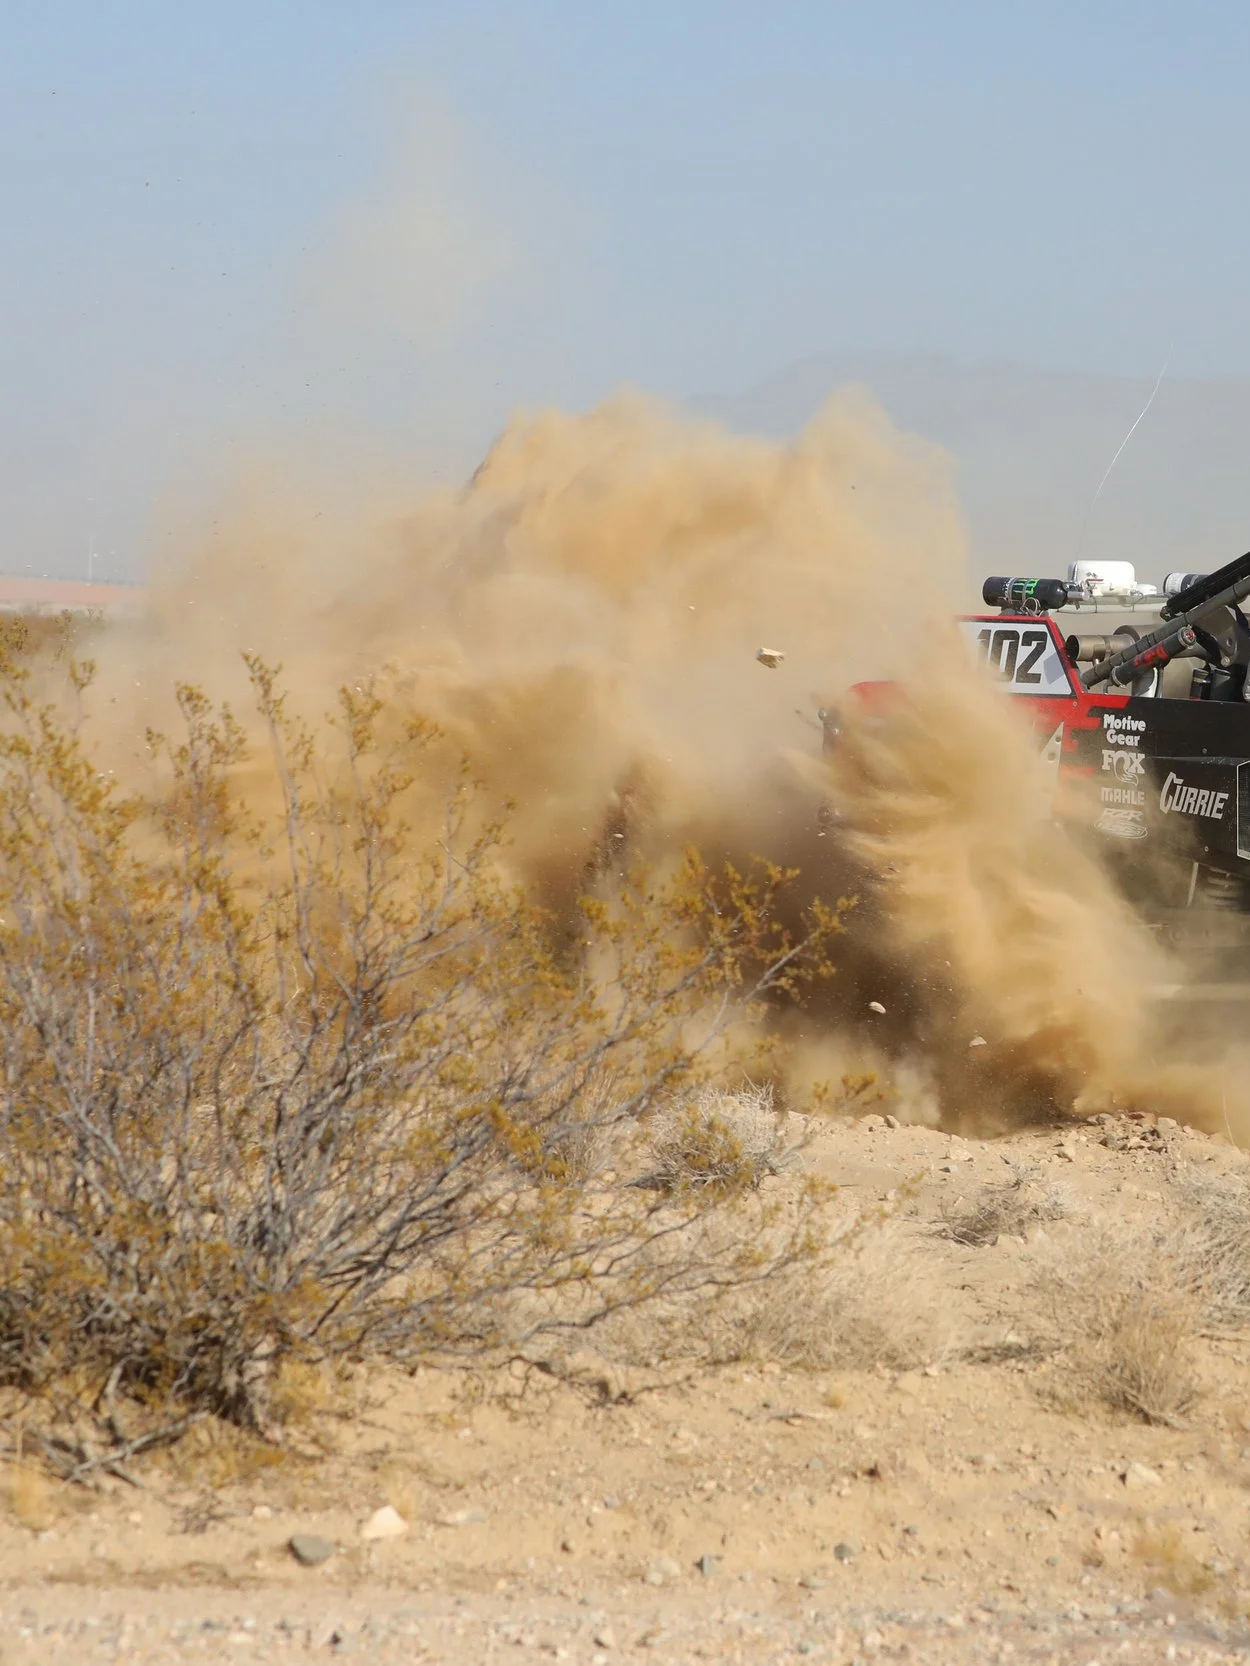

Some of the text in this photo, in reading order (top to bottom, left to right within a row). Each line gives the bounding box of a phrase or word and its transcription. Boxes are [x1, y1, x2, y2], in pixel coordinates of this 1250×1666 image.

[978, 629, 1048, 684] 102
[1103, 714, 1146, 731] Motive
[1106, 730, 1140, 746] Gear
[1102, 750, 1145, 775] FOX
[1101, 787, 1145, 805] MAHLE
[1160, 771, 1229, 820] CURRIE
